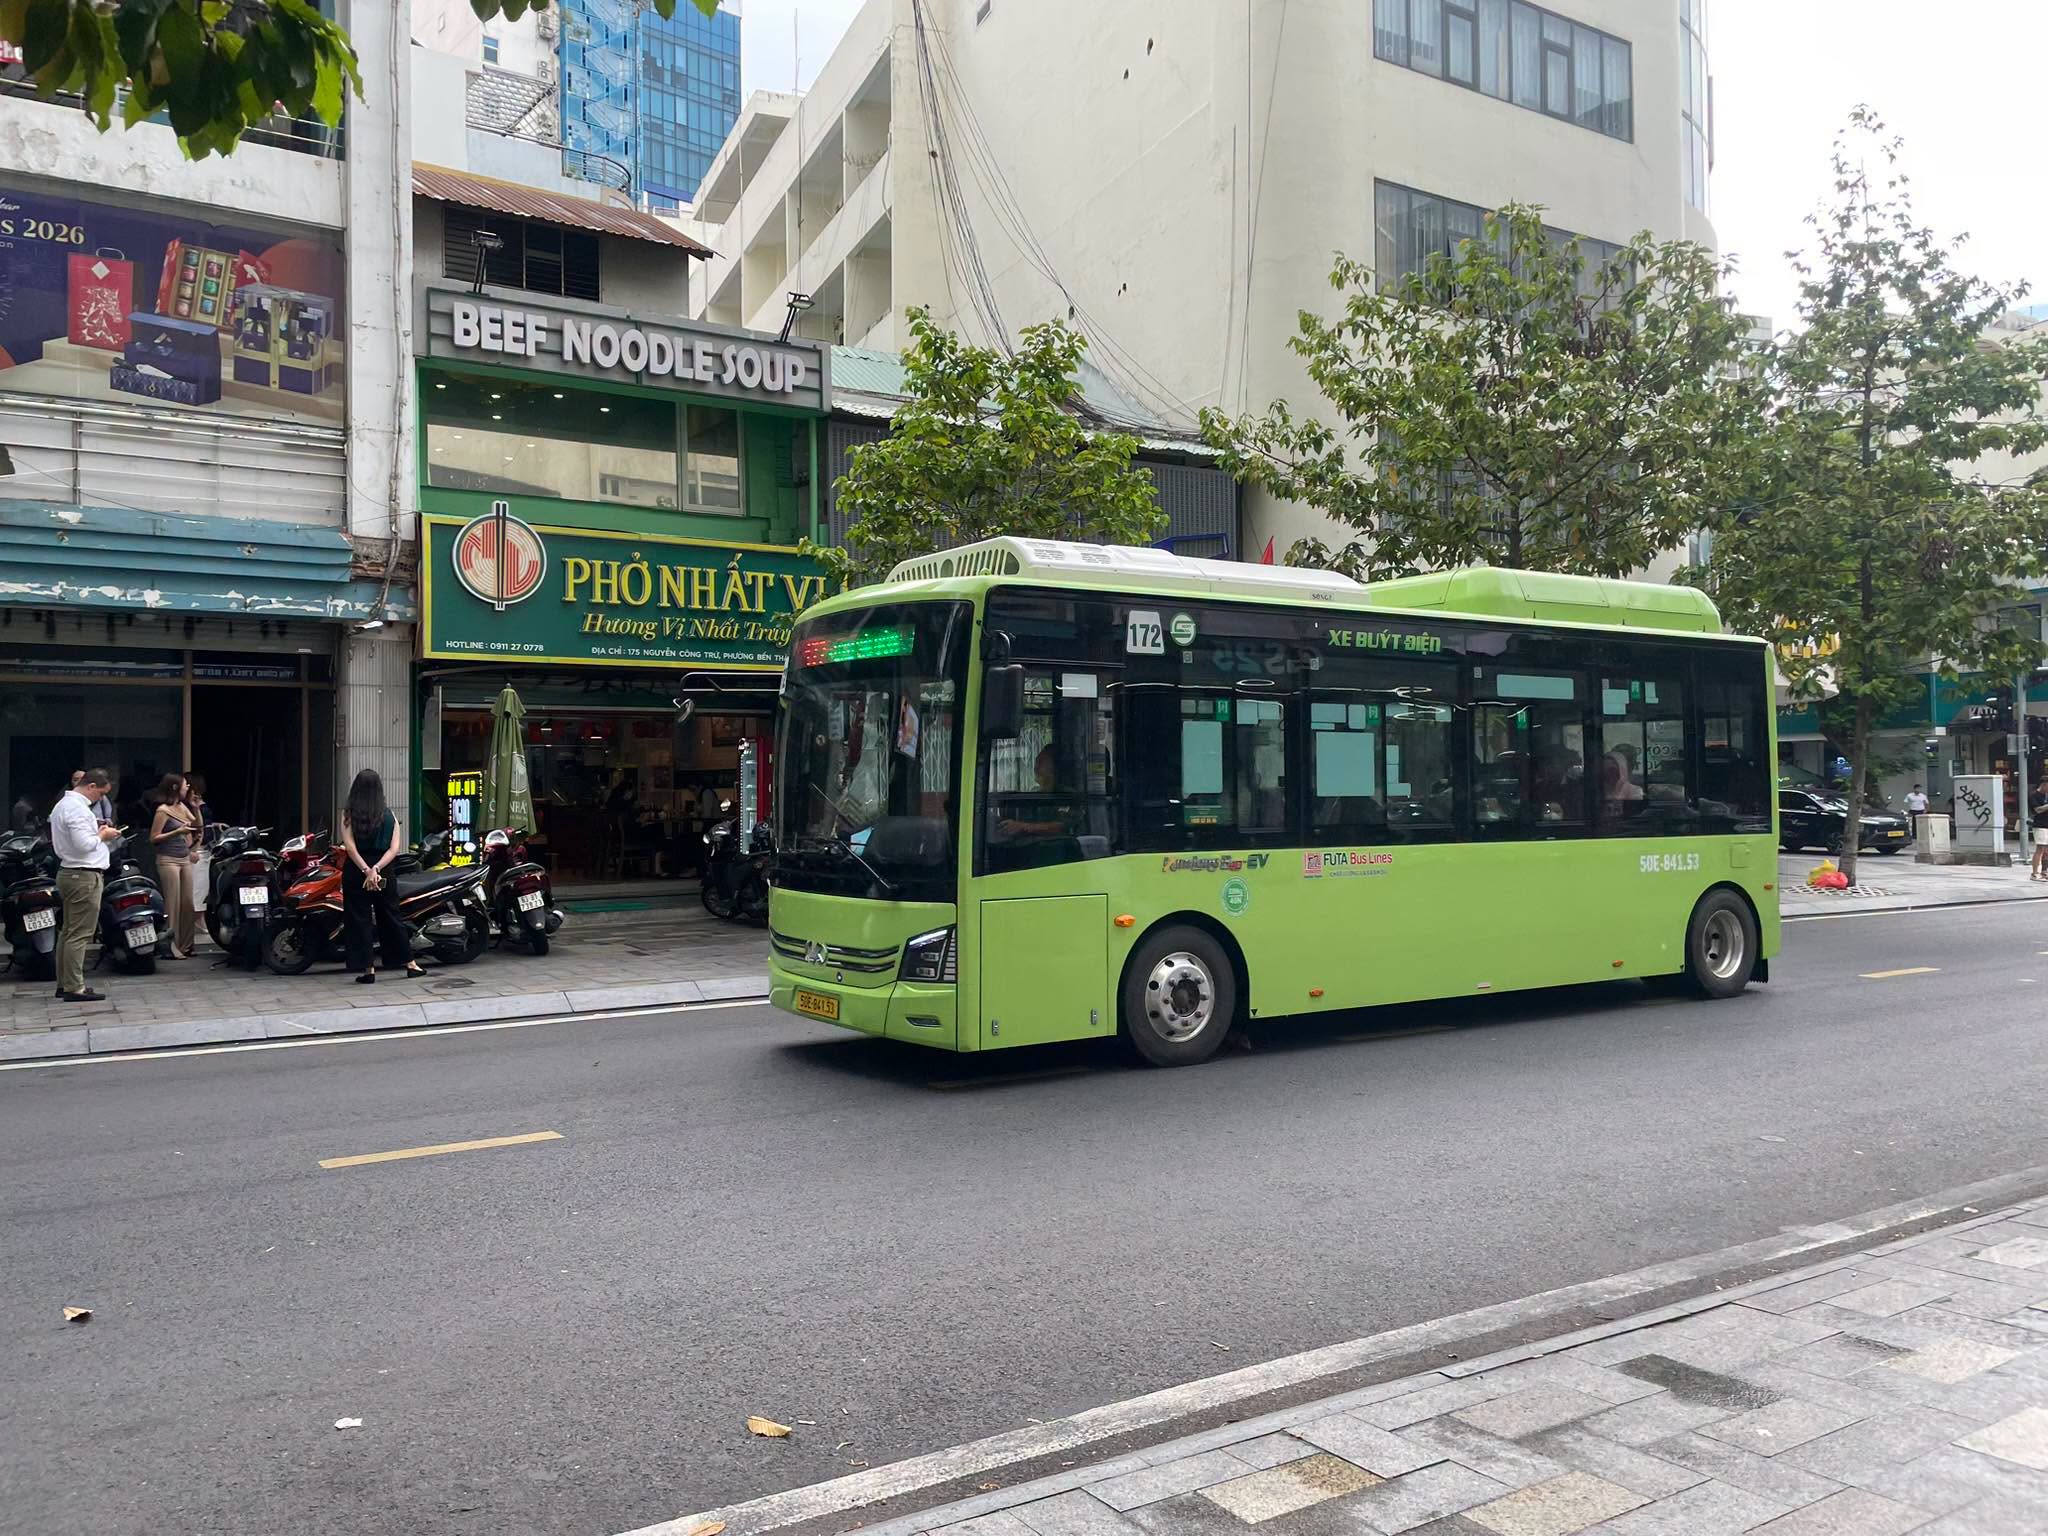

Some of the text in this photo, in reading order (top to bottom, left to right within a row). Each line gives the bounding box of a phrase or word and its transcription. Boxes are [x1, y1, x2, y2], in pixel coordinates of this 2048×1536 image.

[23, 218, 85, 244] 2026
[452, 301, 806, 393] BEEF NOODLE SOUP
[561, 551, 653, 607] PHỞ
[656, 553, 775, 613] NHẤT
[579, 612, 659, 641] Hương
[660, 616, 686, 640] Vị
[687, 616, 741, 640] Nhất
[1129, 623, 1162, 648] 172
[489, 642, 509, 650] 0911
[510, 643, 521, 651] 27
[523, 643, 544, 652] 0778
[591, 646, 606, 656] ĐỊA
[627, 648, 640, 656] 175
[643, 646, 676, 658] NGUYỄN
[679, 649, 702, 658] CÔNG
[723, 650, 754, 661] PHƯỜNG
[757, 650, 772, 661] BẾN
[1327, 628, 1441, 655] XE BUÝT ĐIỆN
[1323, 851, 1393, 866] FUTA Bus Lines
[1640, 853, 1700, 872] 50E-841.53
